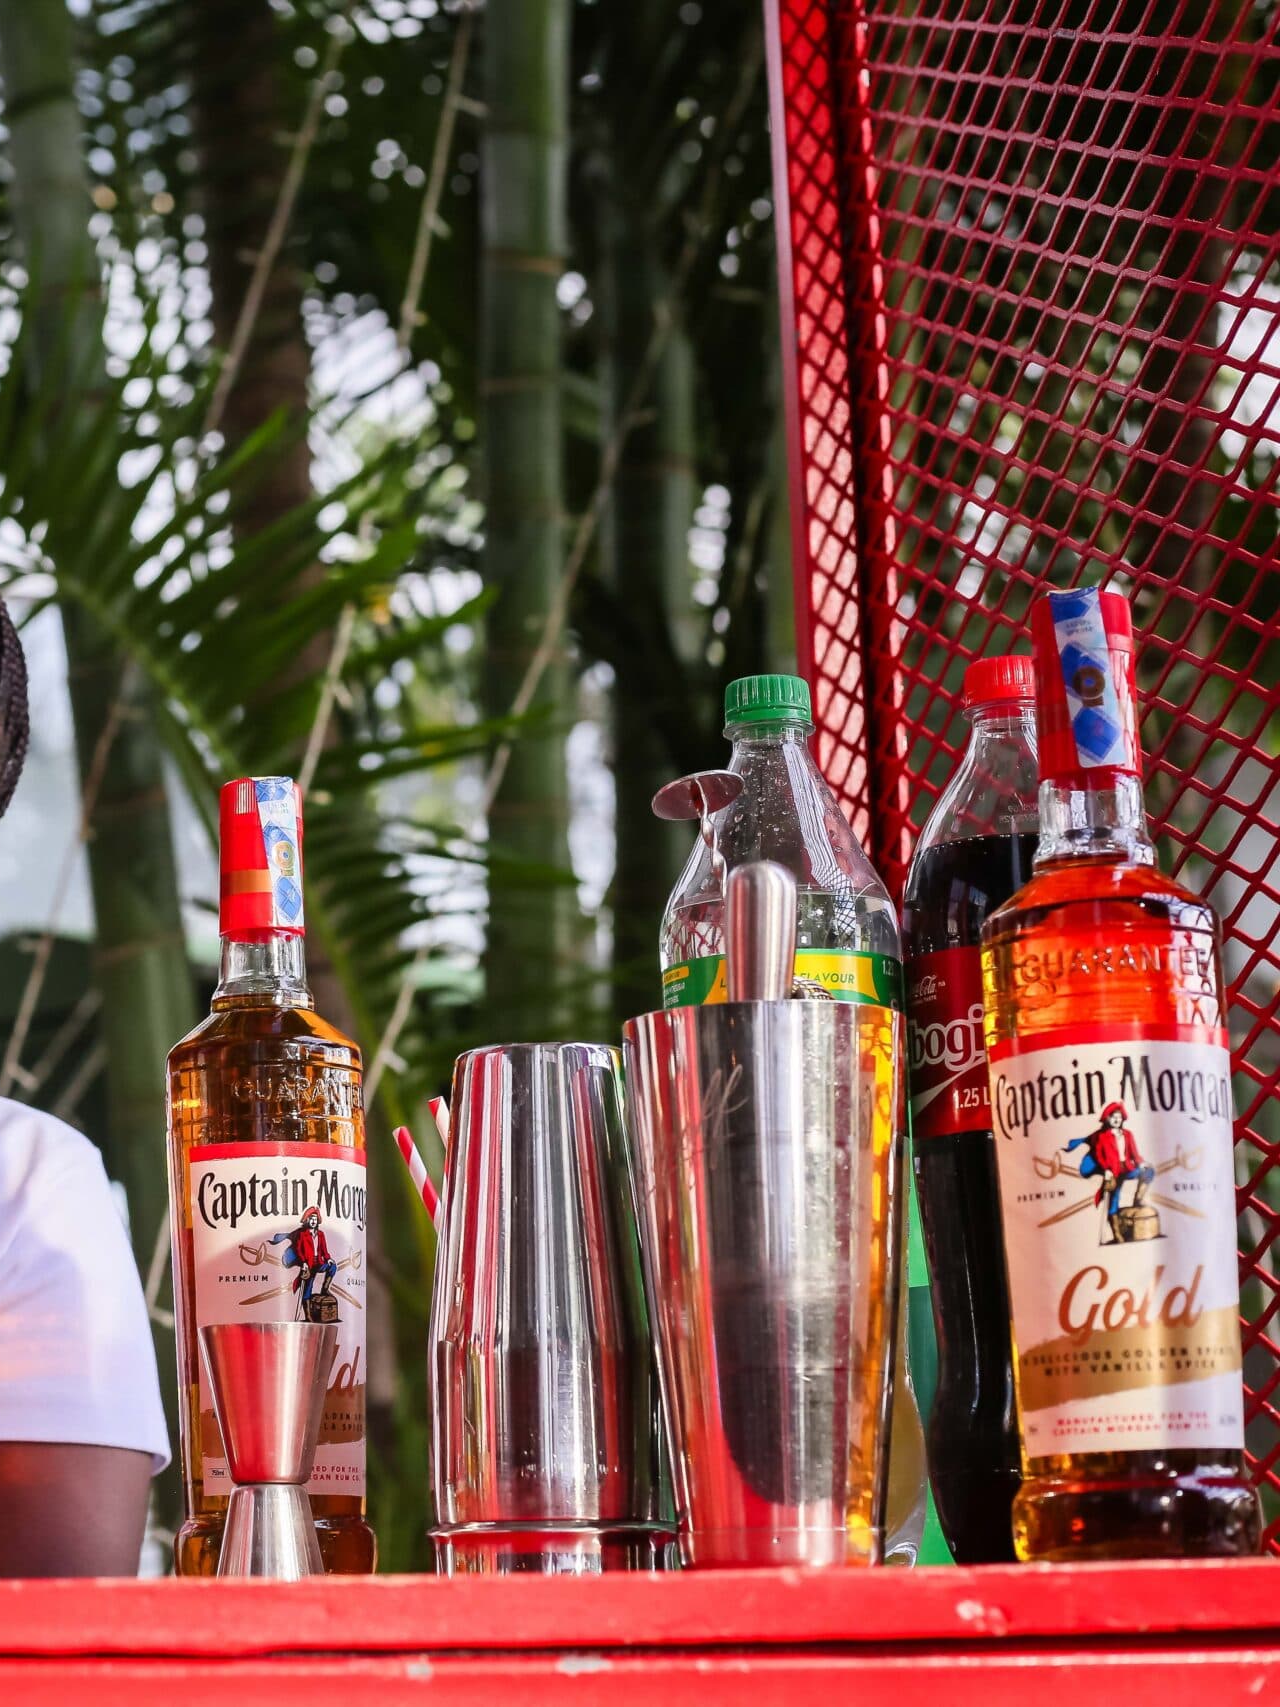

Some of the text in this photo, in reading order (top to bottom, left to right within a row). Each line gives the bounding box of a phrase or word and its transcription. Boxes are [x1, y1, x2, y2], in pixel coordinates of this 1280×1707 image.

[953, 1086, 991, 1110] 1.25 L
[996, 1055, 1231, 1140] Captain Morgan
[198, 1167, 308, 1230] Captain
[218, 1275, 269, 1283] PREMIUM
[1058, 1264, 1205, 1347] Gold
[312, 1473, 331, 1481] GAN
[331, 1465, 346, 1473] FOR
